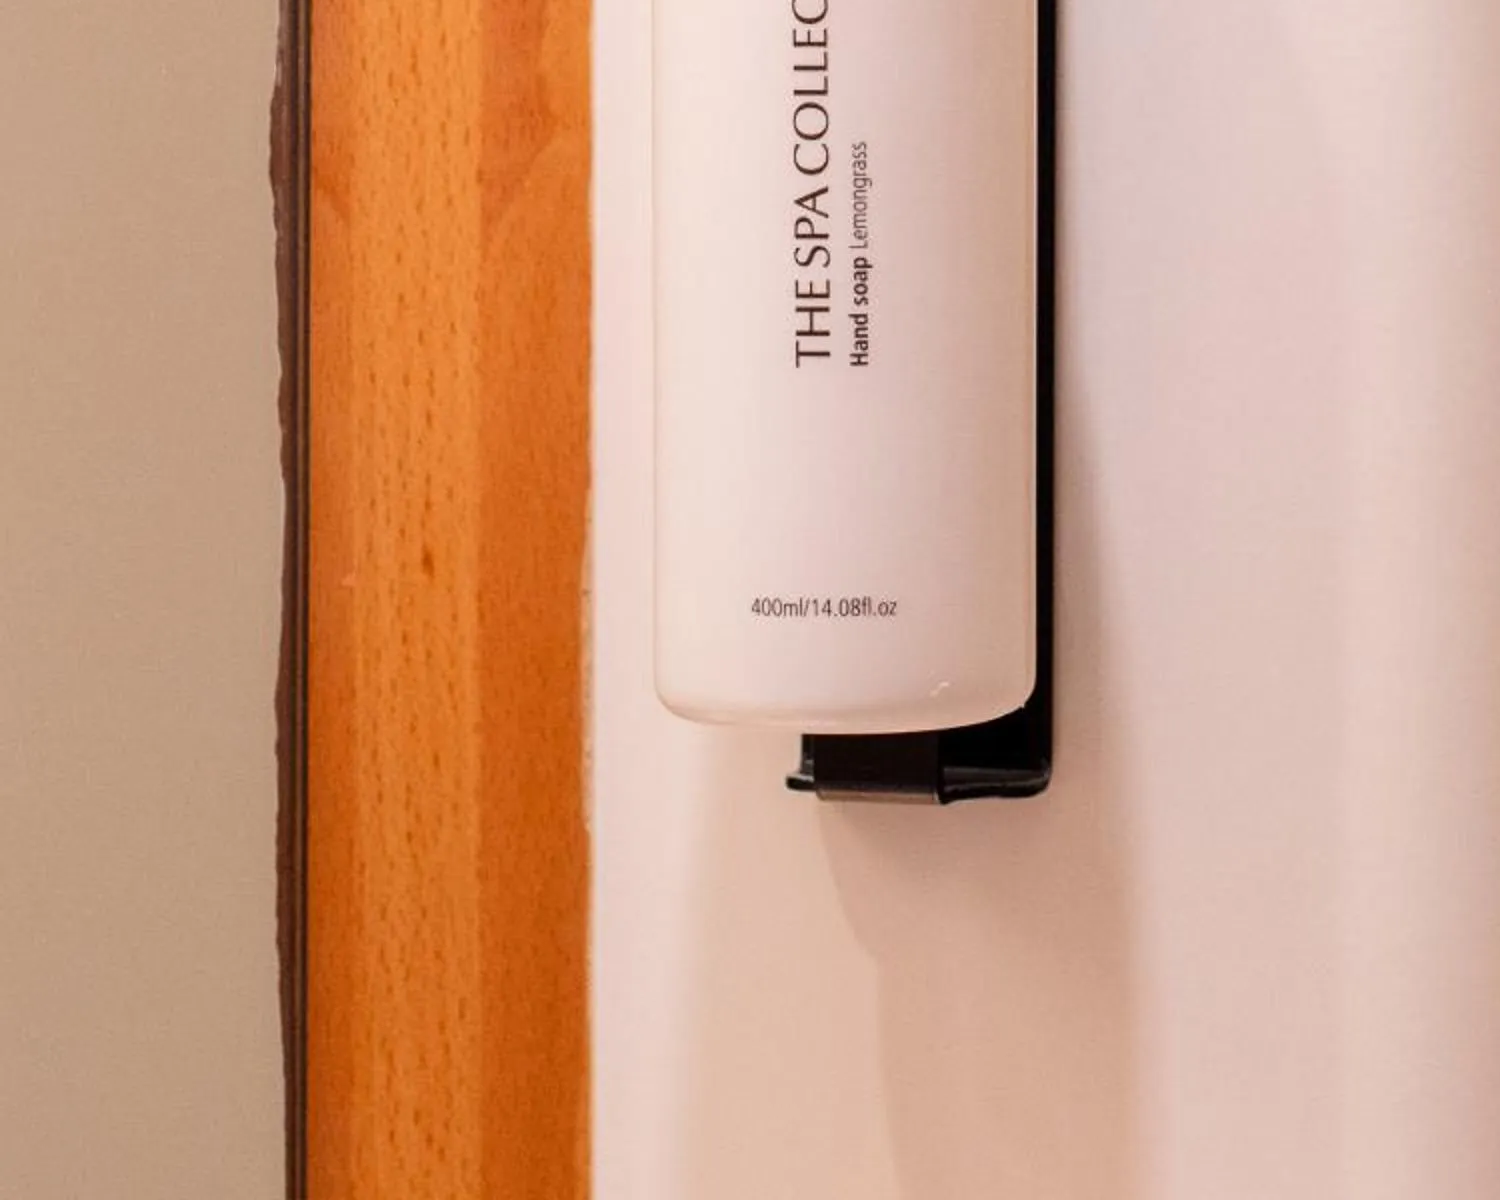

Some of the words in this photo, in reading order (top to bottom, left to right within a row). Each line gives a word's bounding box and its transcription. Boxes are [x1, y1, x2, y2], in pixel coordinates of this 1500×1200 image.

[792, 183, 832, 269] SPA
[848, 140, 873, 250] Lemongrass
[852, 255, 874, 308] soap
[793, 278, 832, 369] THE
[847, 311, 870, 368] Hand
[751, 596, 897, 618] 400ml/14.08fl.oz
